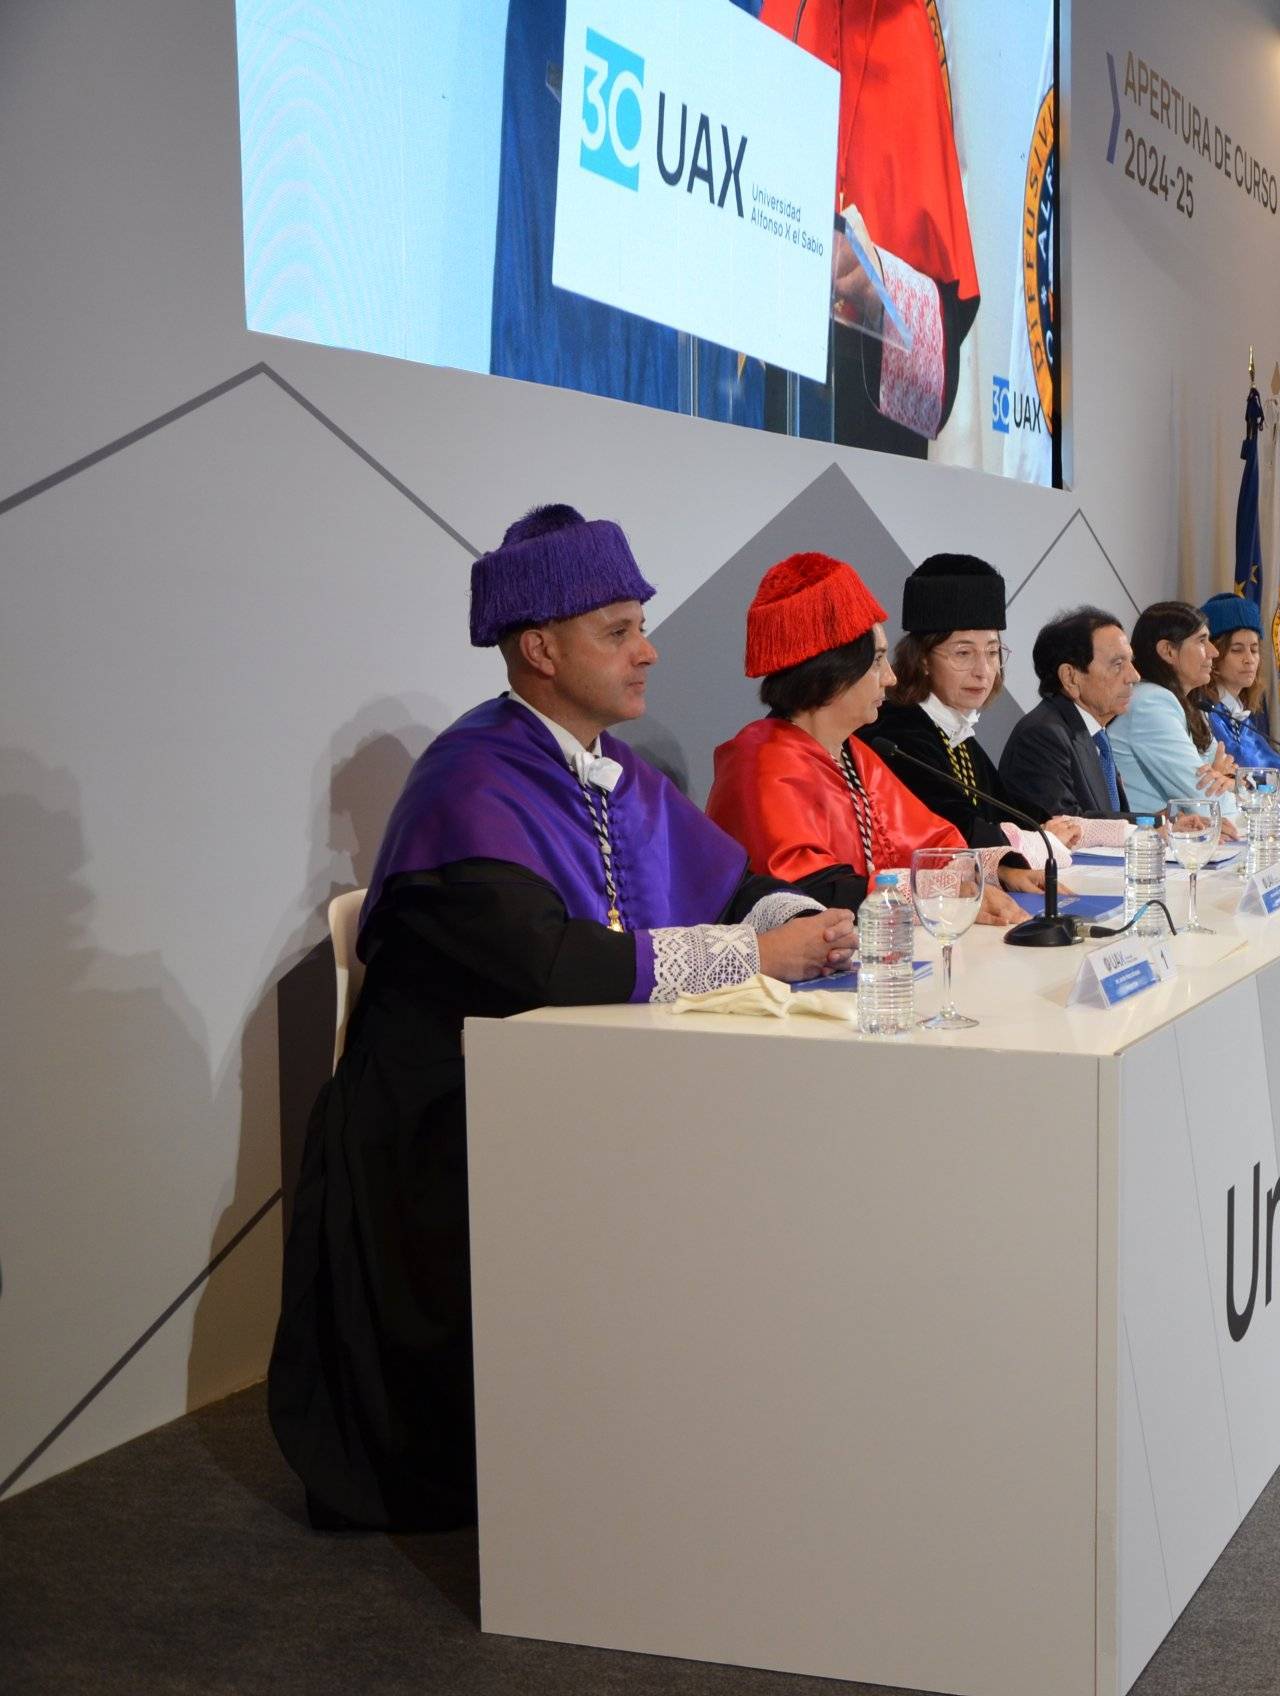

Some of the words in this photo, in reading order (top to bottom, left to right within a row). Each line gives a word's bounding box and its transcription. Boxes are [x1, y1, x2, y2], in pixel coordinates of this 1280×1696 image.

[656, 90, 748, 219] UAX
[1124, 50, 1212, 163] APERTURA
[1215, 125, 1232, 178] DE
[1234, 144, 1278, 214] CURSO
[751, 182, 801, 223] Universidad
[1124, 128, 1194, 218] 2024-25
[750, 206, 784, 238] Alfonso
[784, 221, 791, 241] X
[792, 228, 800, 245] el
[801, 230, 824, 257] Sabio
[1013, 391, 1042, 433] UAX
